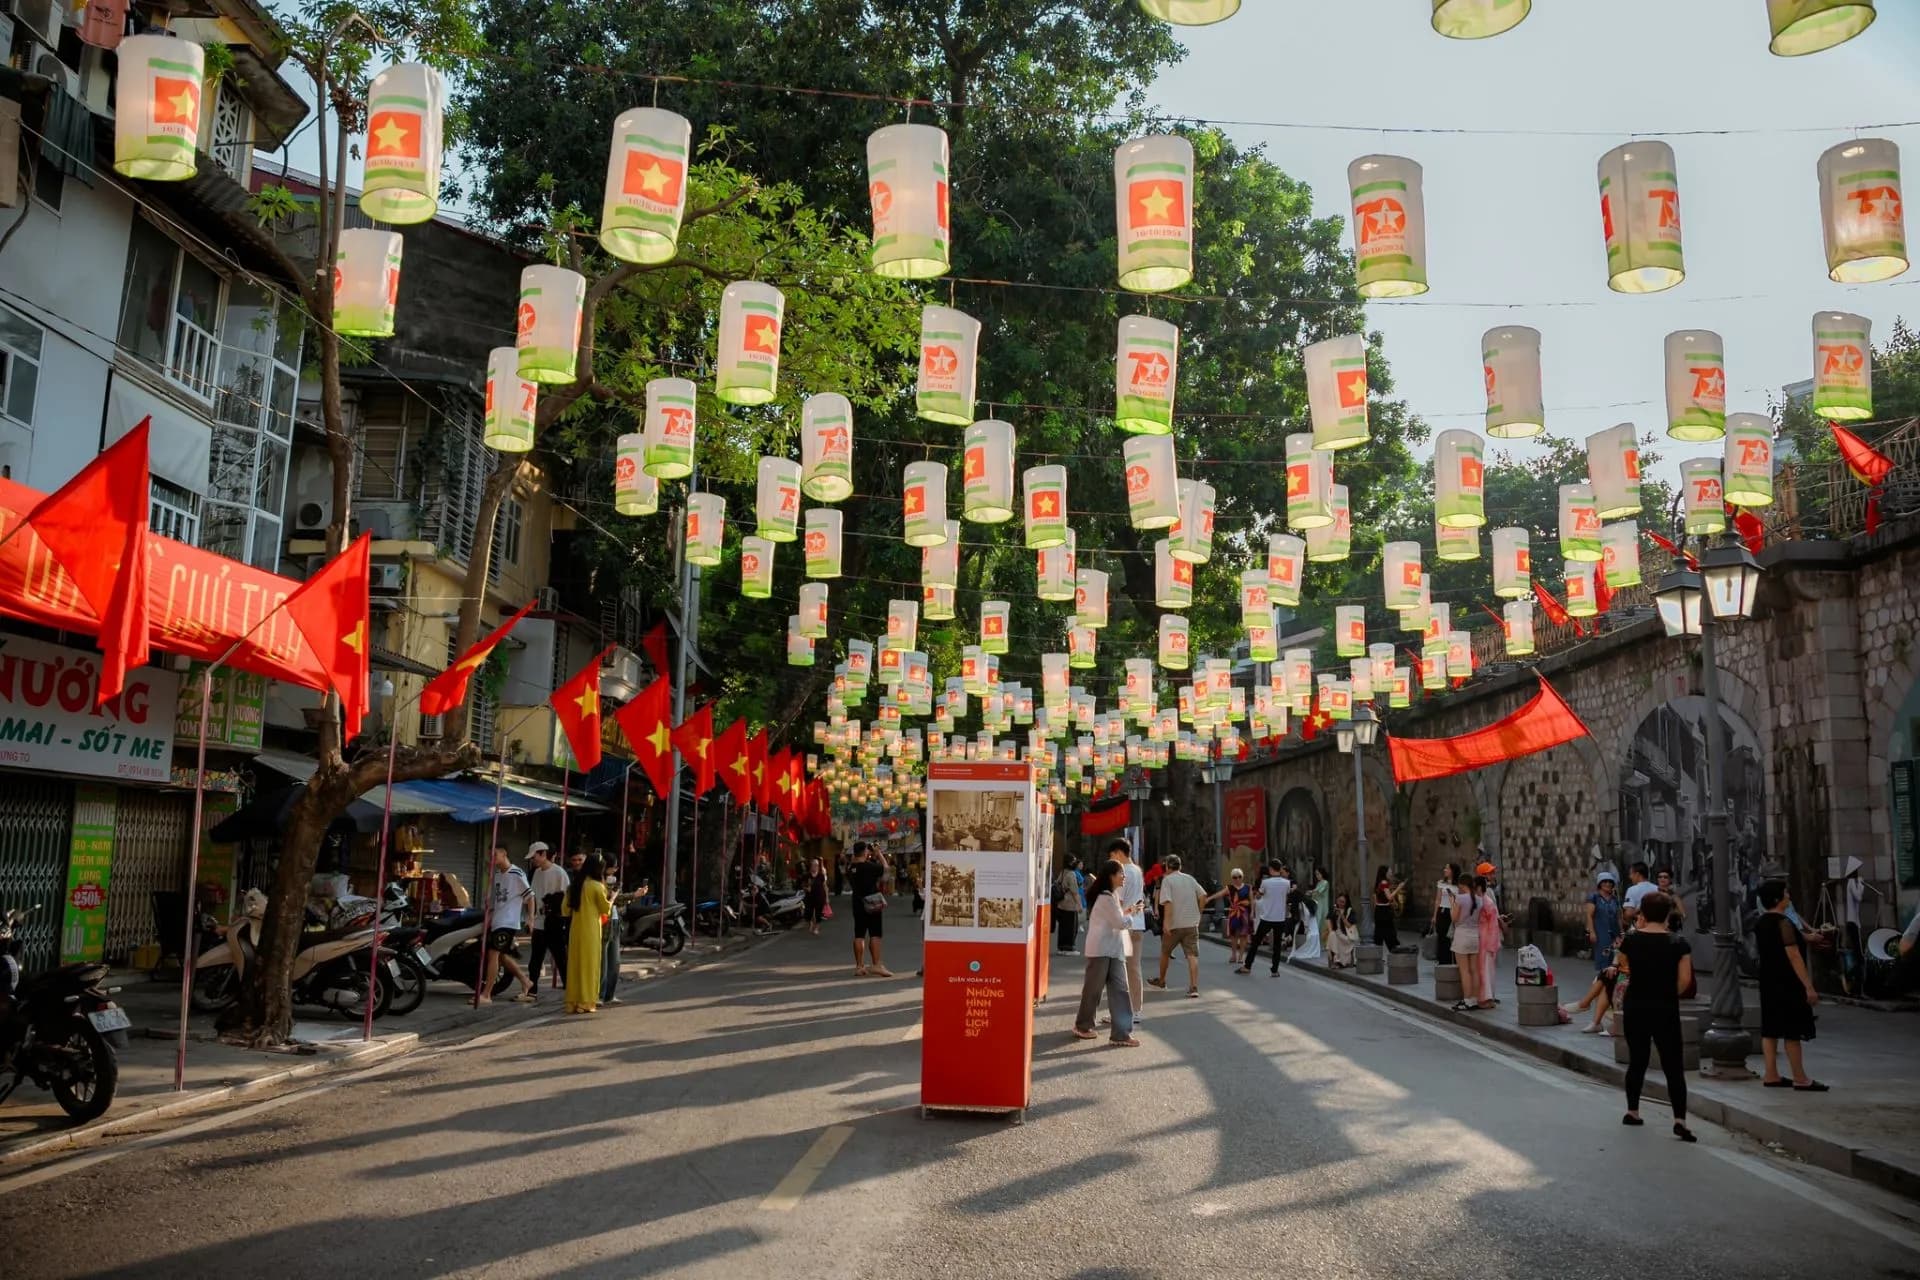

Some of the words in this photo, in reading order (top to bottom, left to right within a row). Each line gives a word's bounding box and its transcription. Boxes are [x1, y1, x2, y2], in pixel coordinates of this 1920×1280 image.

[1355, 198, 1406, 245] 70
[1128, 352, 1170, 385] 70
[1819, 344, 1864, 375] 70
[661, 408, 693, 435] 70
[818, 427, 849, 457] 70
[1737, 439, 1769, 466] 70
[1692, 479, 1720, 502] 70
[1571, 508, 1601, 531] 70
[78, 723, 127, 755] SỐT
[128, 736, 165, 761] ME
